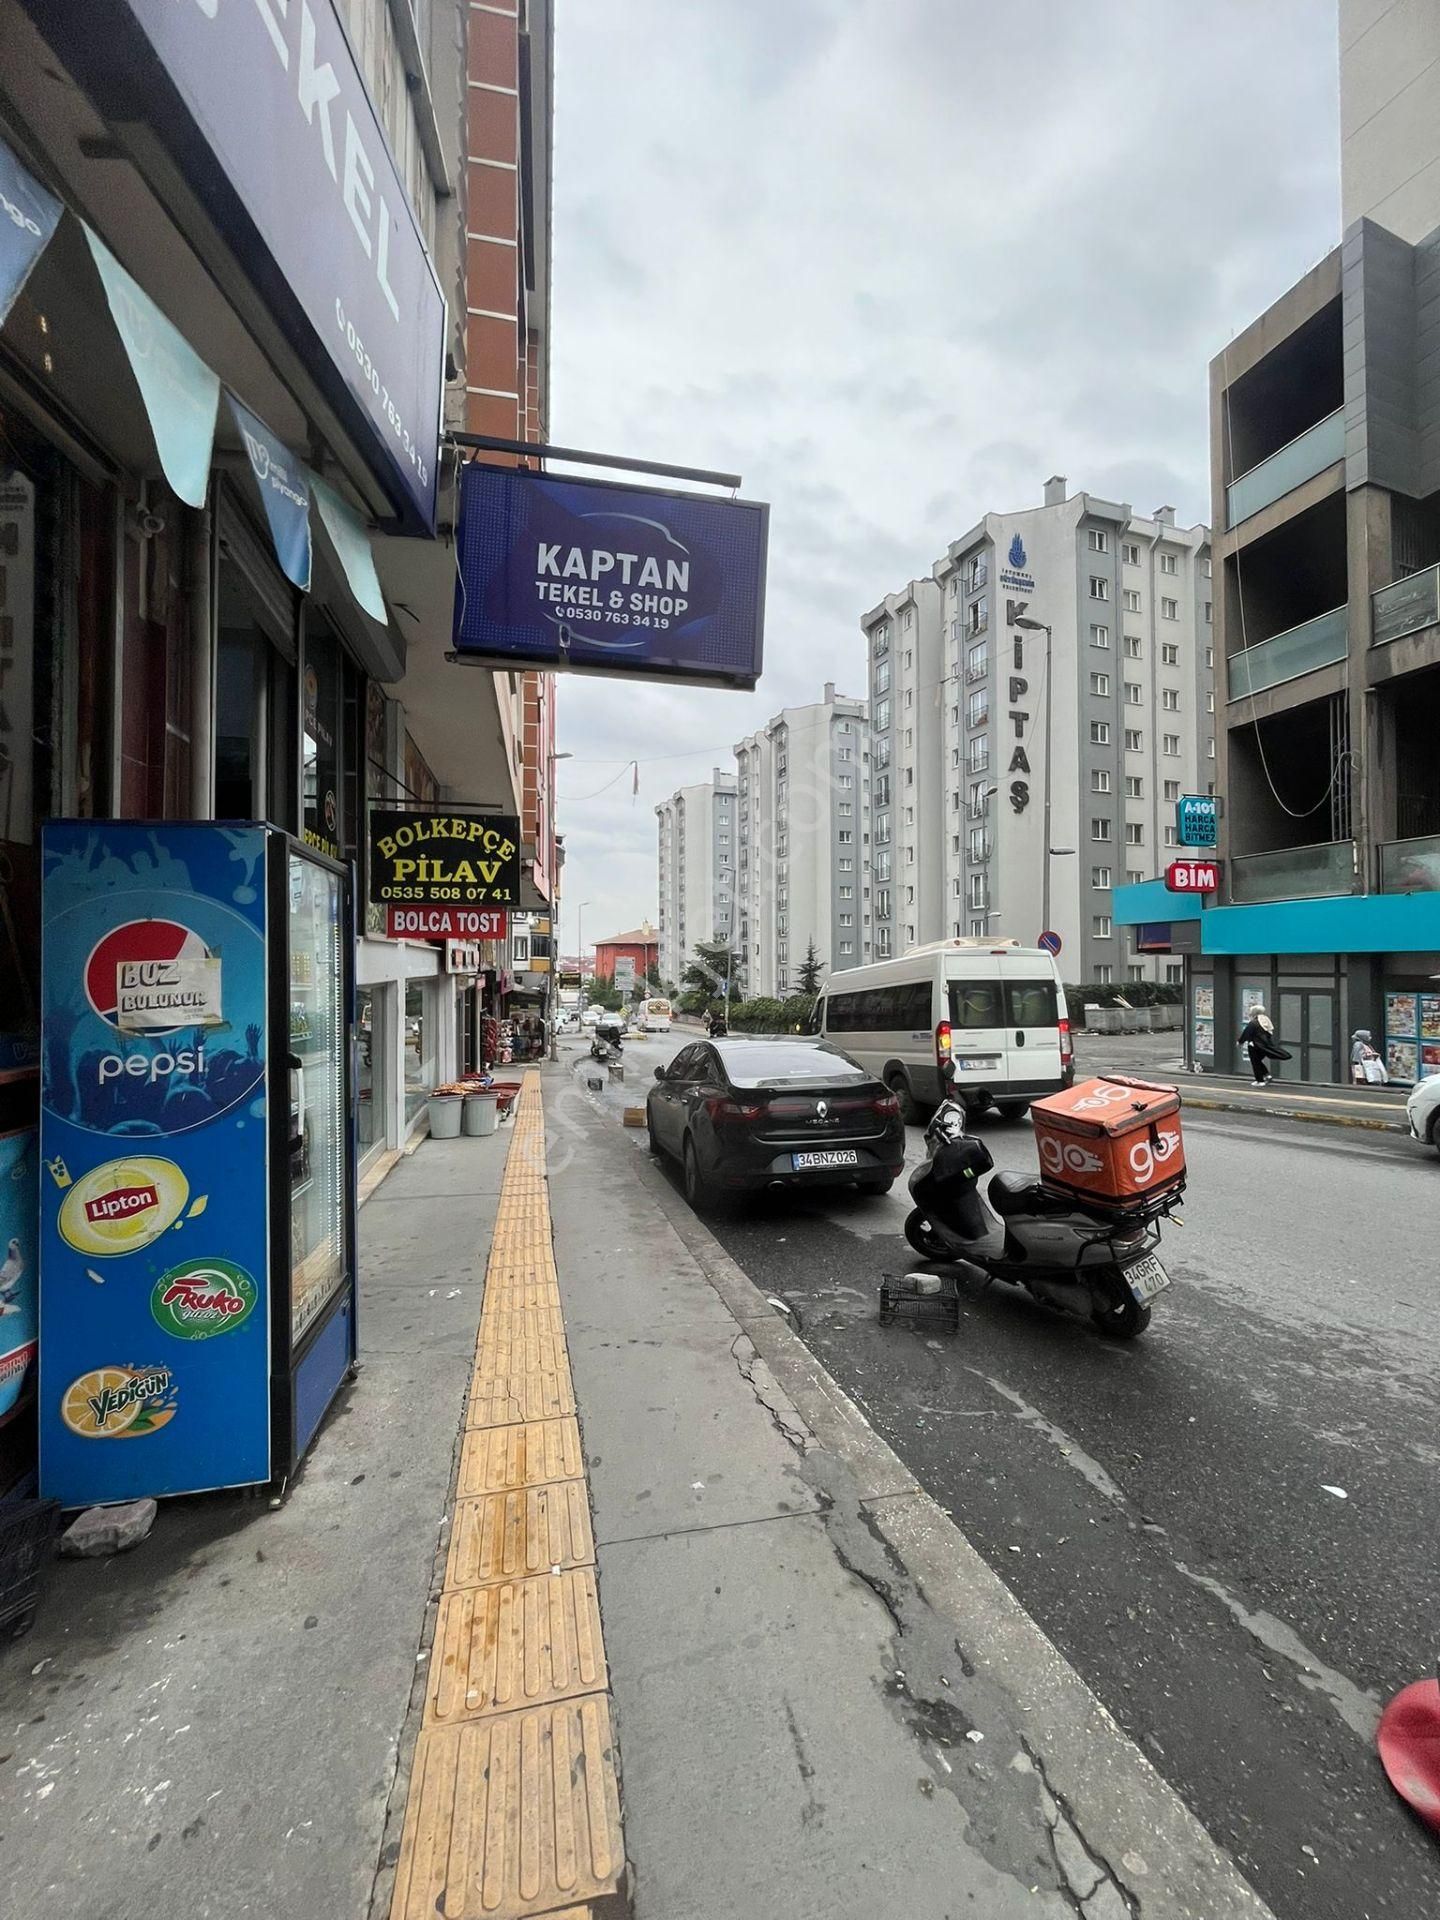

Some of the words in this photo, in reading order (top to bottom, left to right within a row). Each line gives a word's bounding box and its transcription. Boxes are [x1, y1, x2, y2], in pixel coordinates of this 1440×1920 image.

[346, 320, 380, 396] 0530
[381, 385, 402, 438] 763
[537, 542, 690, 593] KAPTAN
[535, 581, 604, 607] TEKEL
[608, 590, 625, 609] &
[629, 592, 689, 617] SHOP
[566, 607, 602, 622] 0530
[604, 611, 630, 625] 763
[632, 614, 650, 627] 34
[652, 617, 670, 630] 19
[1006, 599, 1031, 814] KİPTAŞ
[1184, 815, 1216, 825] HARCA
[1184, 824, 1216, 833] HARCA
[376, 818, 516, 862] BOLKEPÇE
[392, 853, 503, 884] PİLAV
[1174, 864, 1215, 888] BİM
[381, 886, 425, 900] 0535
[429, 887, 461, 900] 508
[466, 888, 487, 900] 07
[491, 888, 512, 901] 41
[394, 911, 453, 932] BOLCA
[457, 912, 501, 933] TOST
[120, 961, 181, 989] BUZ
[121, 990, 208, 1013] BULUNUR
[99, 1046, 205, 1085] pepsi
[798, 1150, 857, 1167] 34BNZ026
[1039, 1136, 1104, 1174] go
[1129, 1130, 1180, 1184] go
[92, 1190, 152, 1217] Lipton
[1124, 1256, 1158, 1285] 34GRF
[1143, 1272, 1165, 1292] 470
